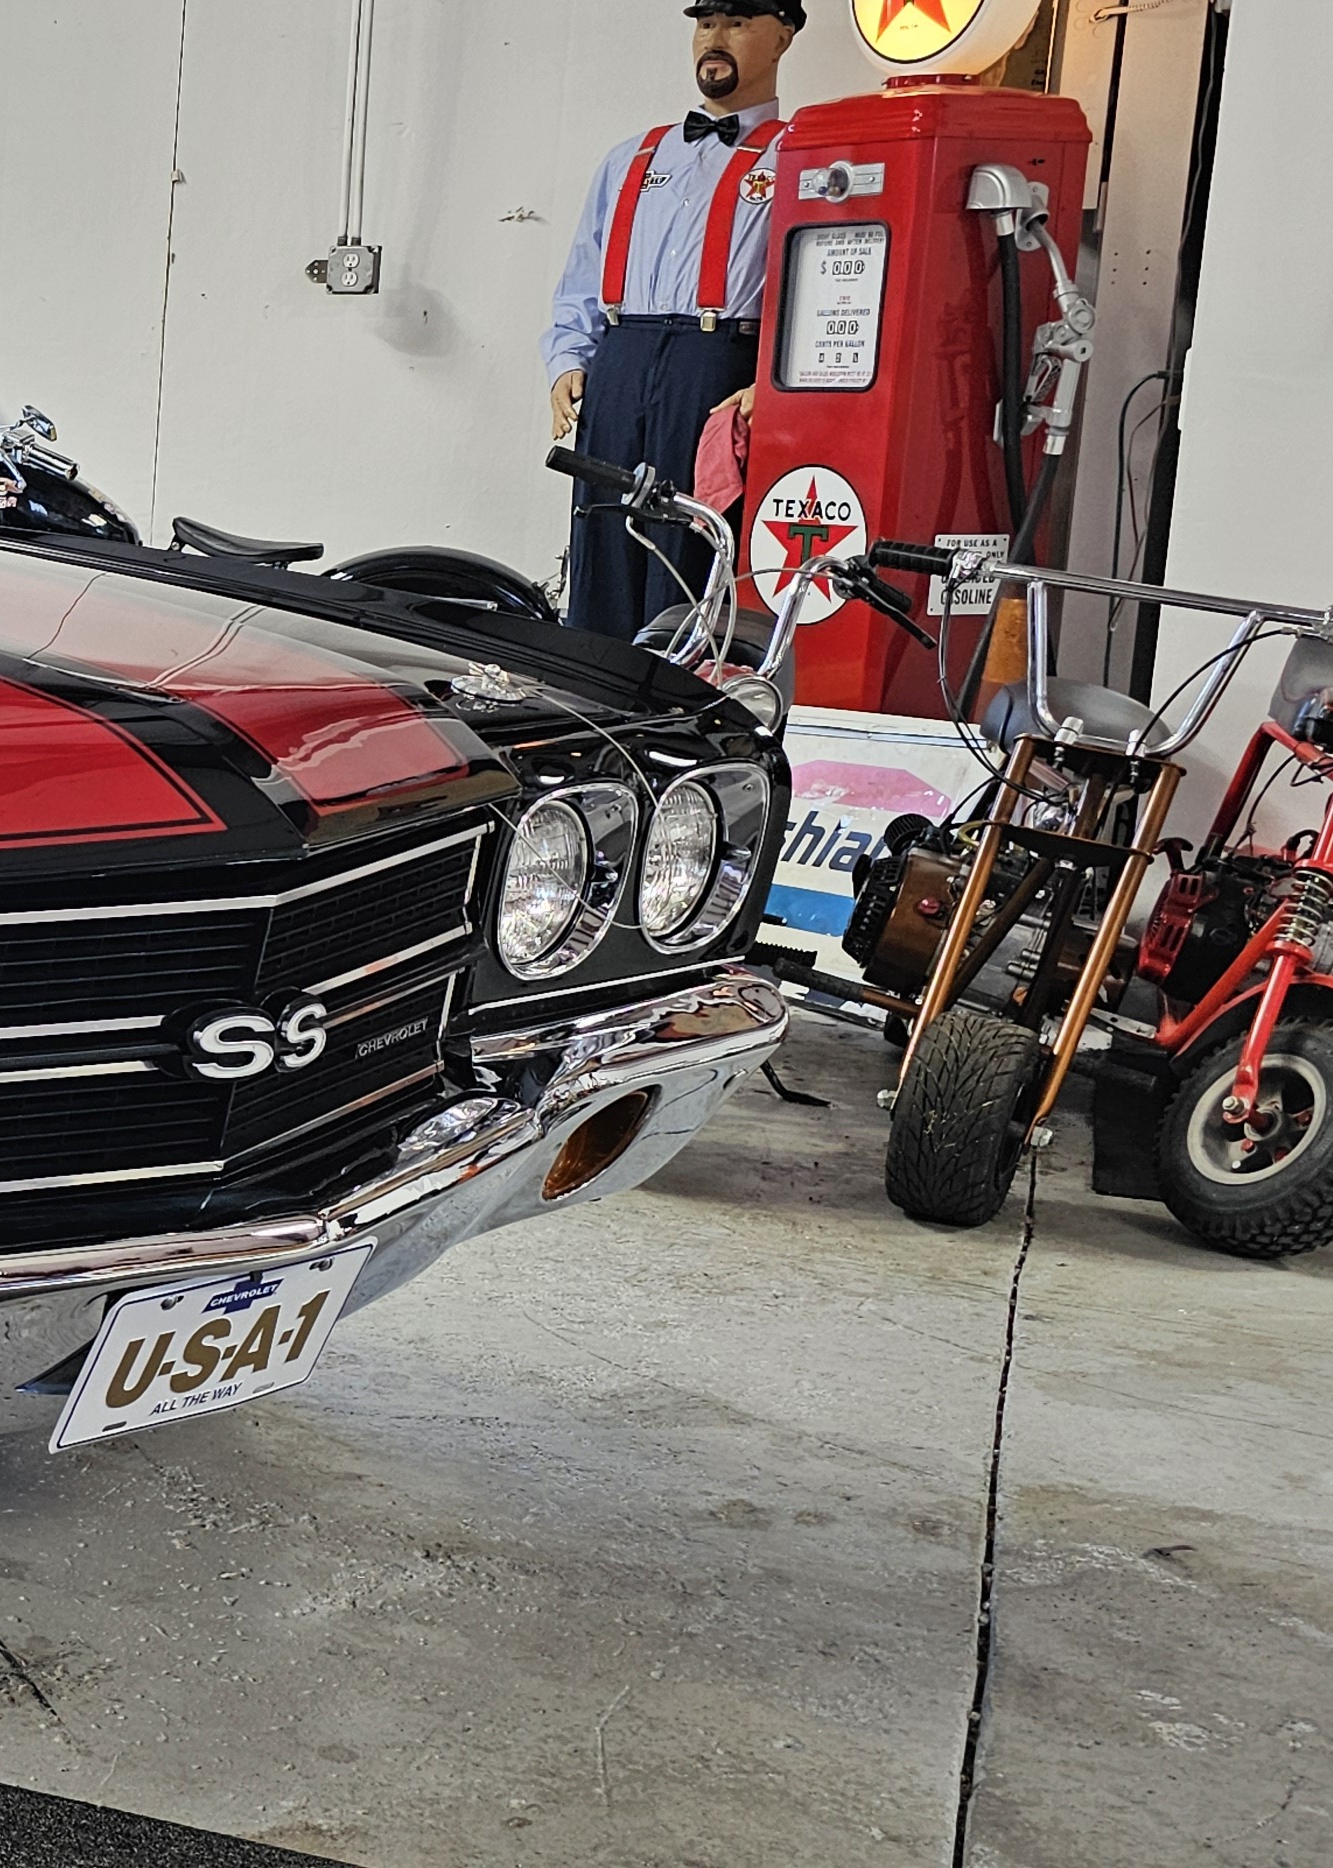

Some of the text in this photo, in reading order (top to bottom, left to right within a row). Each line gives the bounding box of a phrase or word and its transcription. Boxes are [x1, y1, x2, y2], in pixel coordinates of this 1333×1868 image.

[773, 498, 852, 522] TEXACO
[946, 539, 998, 547] FOR USE AS A
[985, 551, 1005, 559] ONLY
[192, 1002, 328, 1079] SS
[357, 1017, 430, 1058] CHEVROLET
[209, 1283, 279, 1308] CHEVROLET
[150, 1382, 244, 1416] ALL THE WAY
